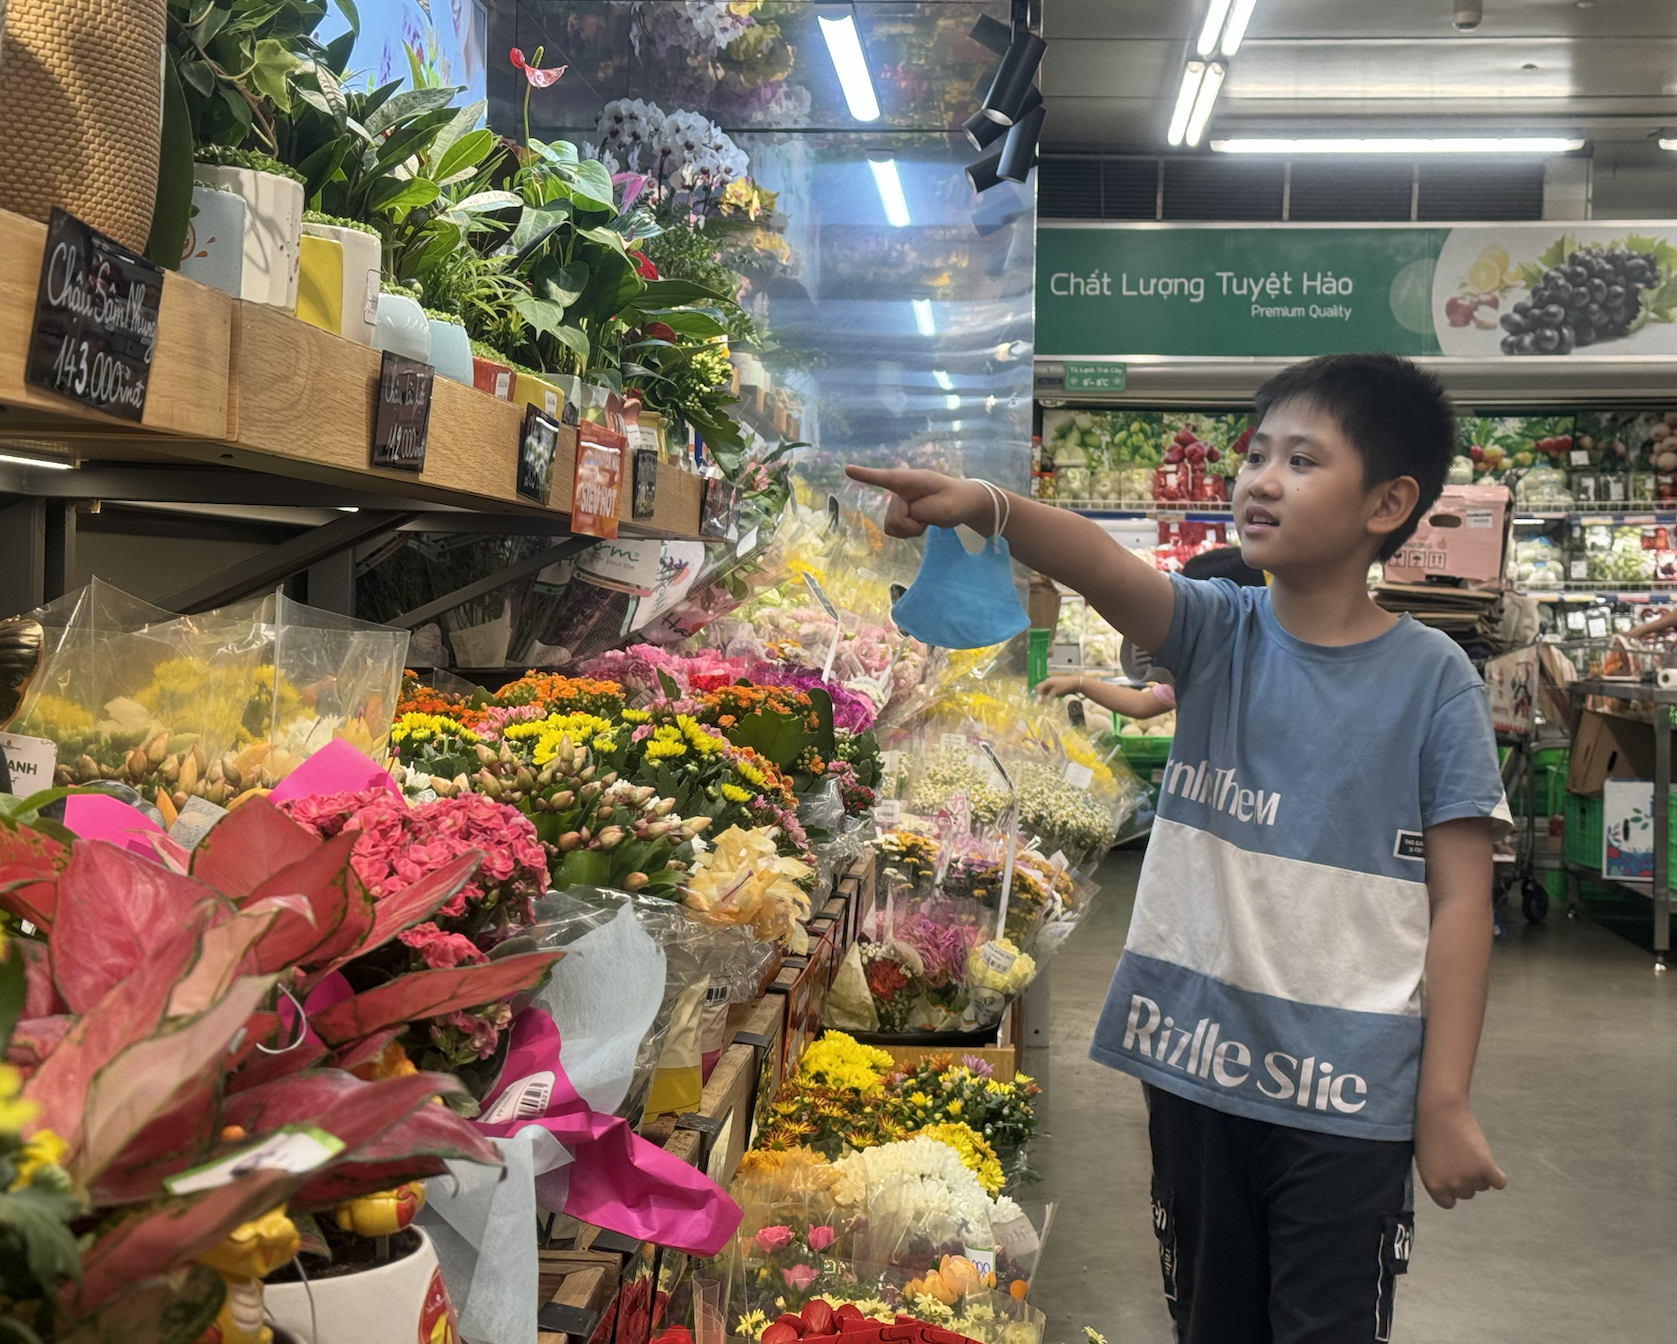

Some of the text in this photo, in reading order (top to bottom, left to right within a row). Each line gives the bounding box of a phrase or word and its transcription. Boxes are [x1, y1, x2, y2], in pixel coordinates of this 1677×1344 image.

[1050, 269, 1354, 302] Chất Lượng Tuyệt Hảo
[1251, 304, 1353, 321] Premium Quality
[1122, 994, 1368, 1114] Rizlle Slic
